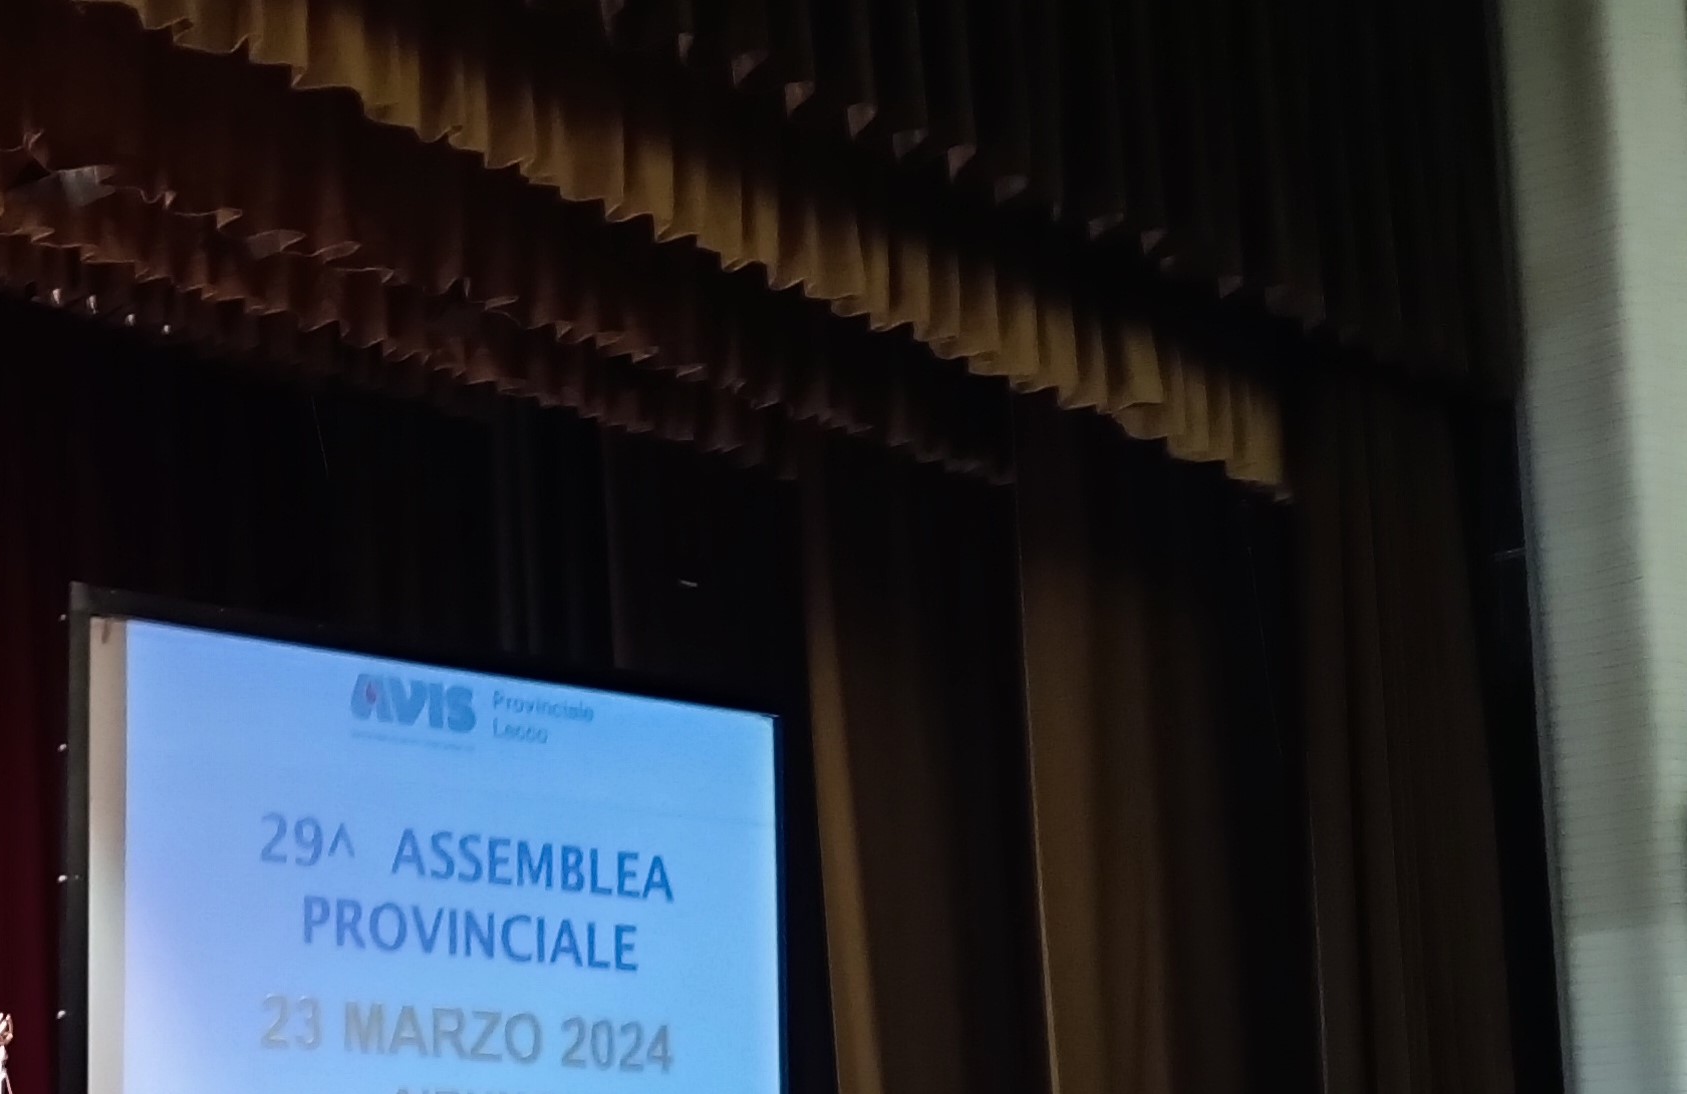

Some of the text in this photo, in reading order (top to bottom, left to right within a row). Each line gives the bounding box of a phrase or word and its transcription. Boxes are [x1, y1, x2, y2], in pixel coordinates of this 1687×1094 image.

[350, 673, 476, 733] AVIS
[391, 829, 675, 902] ASSEMBLEA
[304, 895, 639, 972] PROVINCIALE
[260, 996, 674, 1074] 23 MARZO 2024
